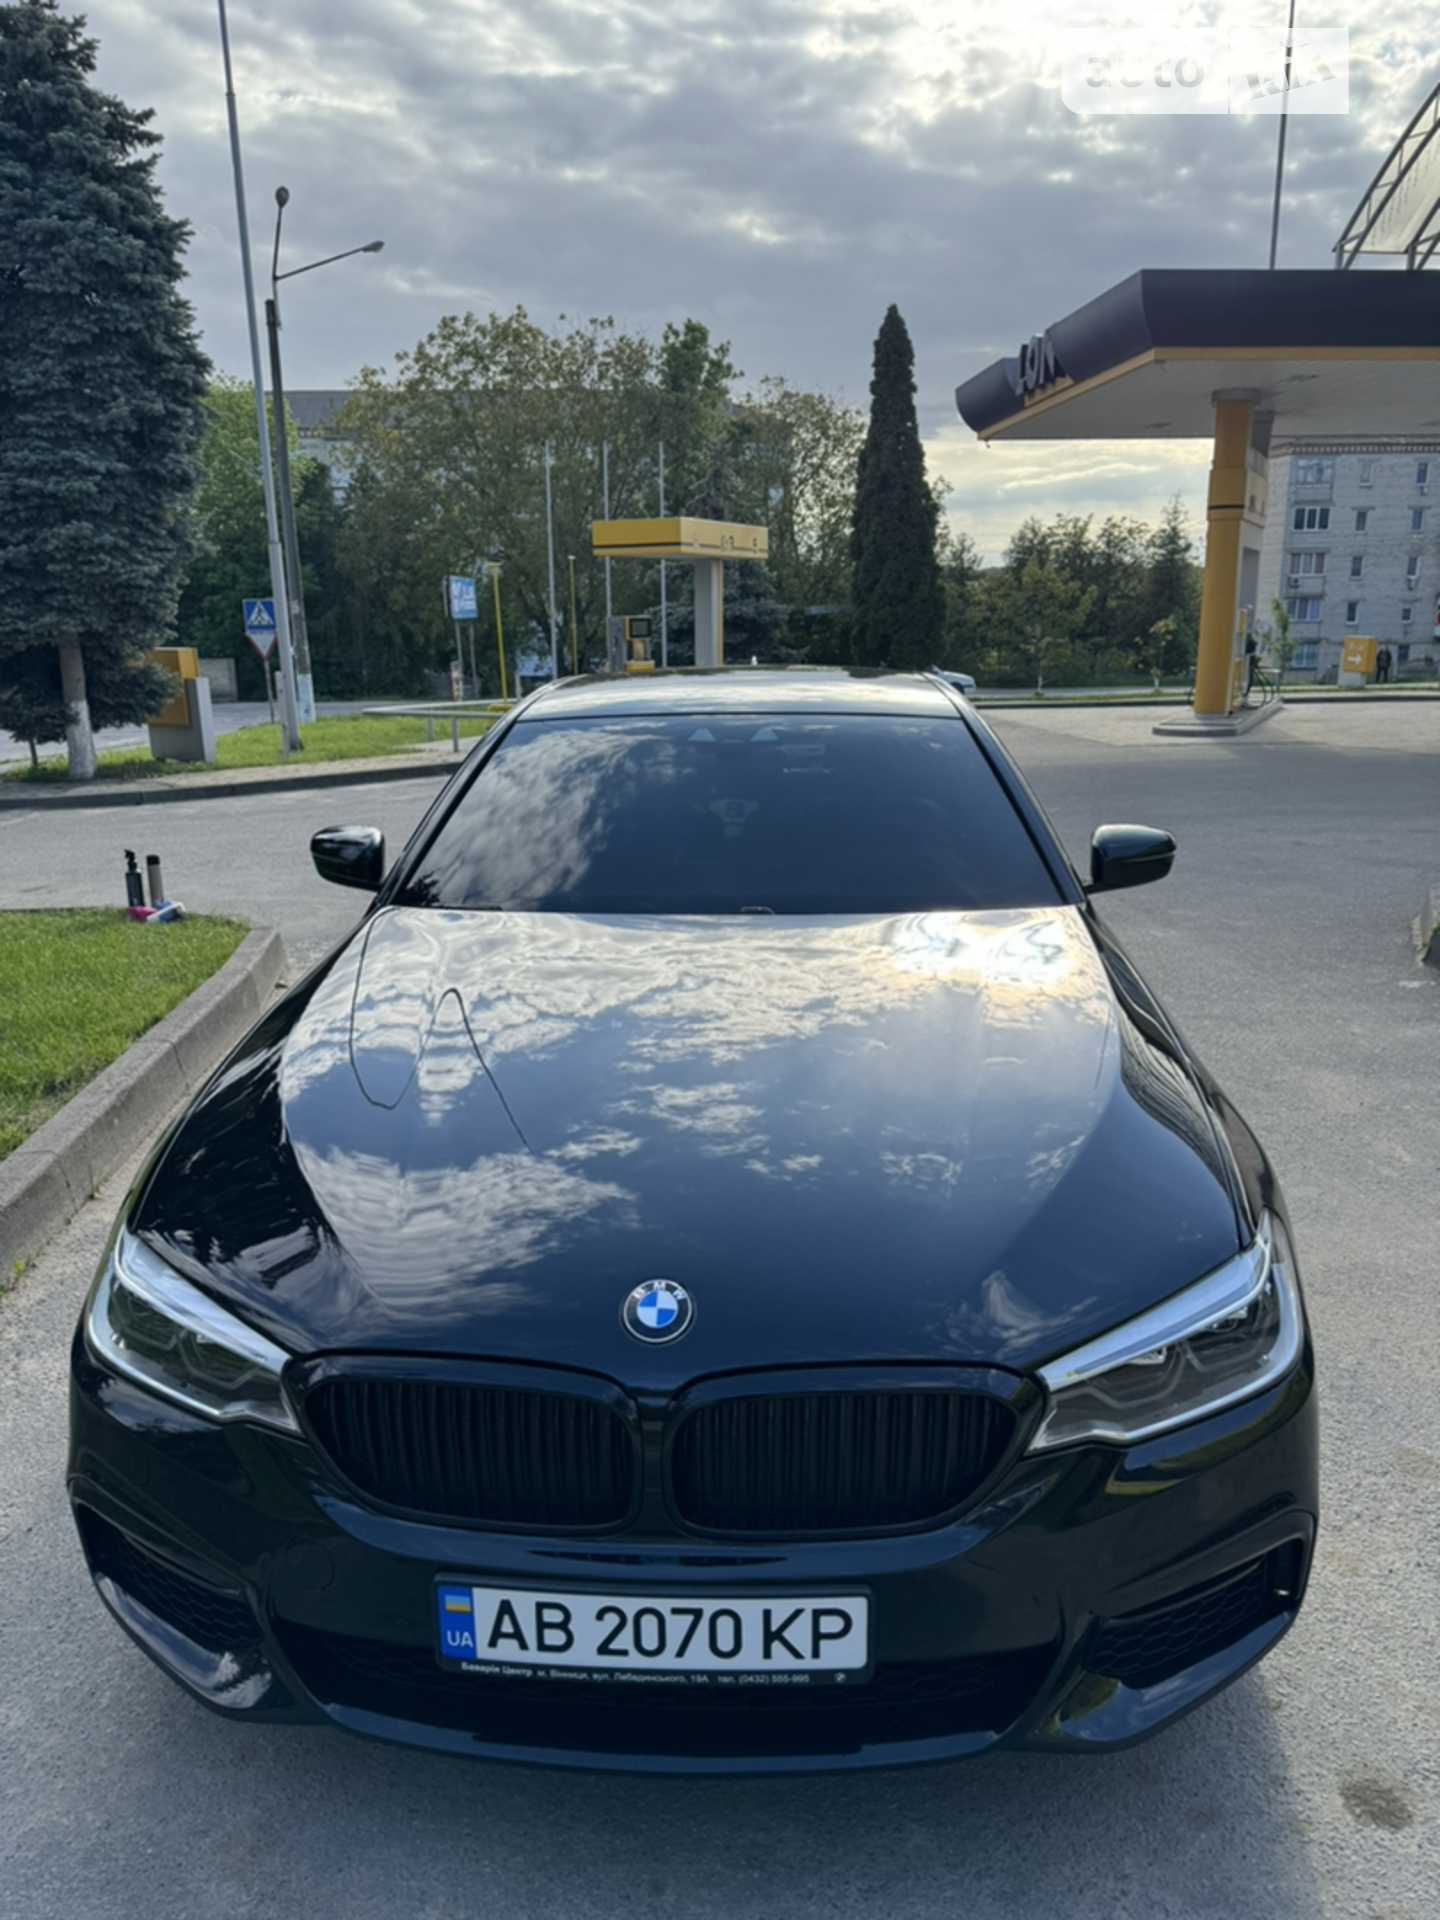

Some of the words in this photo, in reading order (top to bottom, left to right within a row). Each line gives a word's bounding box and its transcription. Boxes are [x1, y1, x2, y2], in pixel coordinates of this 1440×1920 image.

[632, 1280, 686, 1300] BMW
[447, 1630, 474, 1648] UA
[487, 1598, 575, 1654] AB
[595, 1605, 743, 1660] 2070
[762, 1607, 853, 1660] KP
